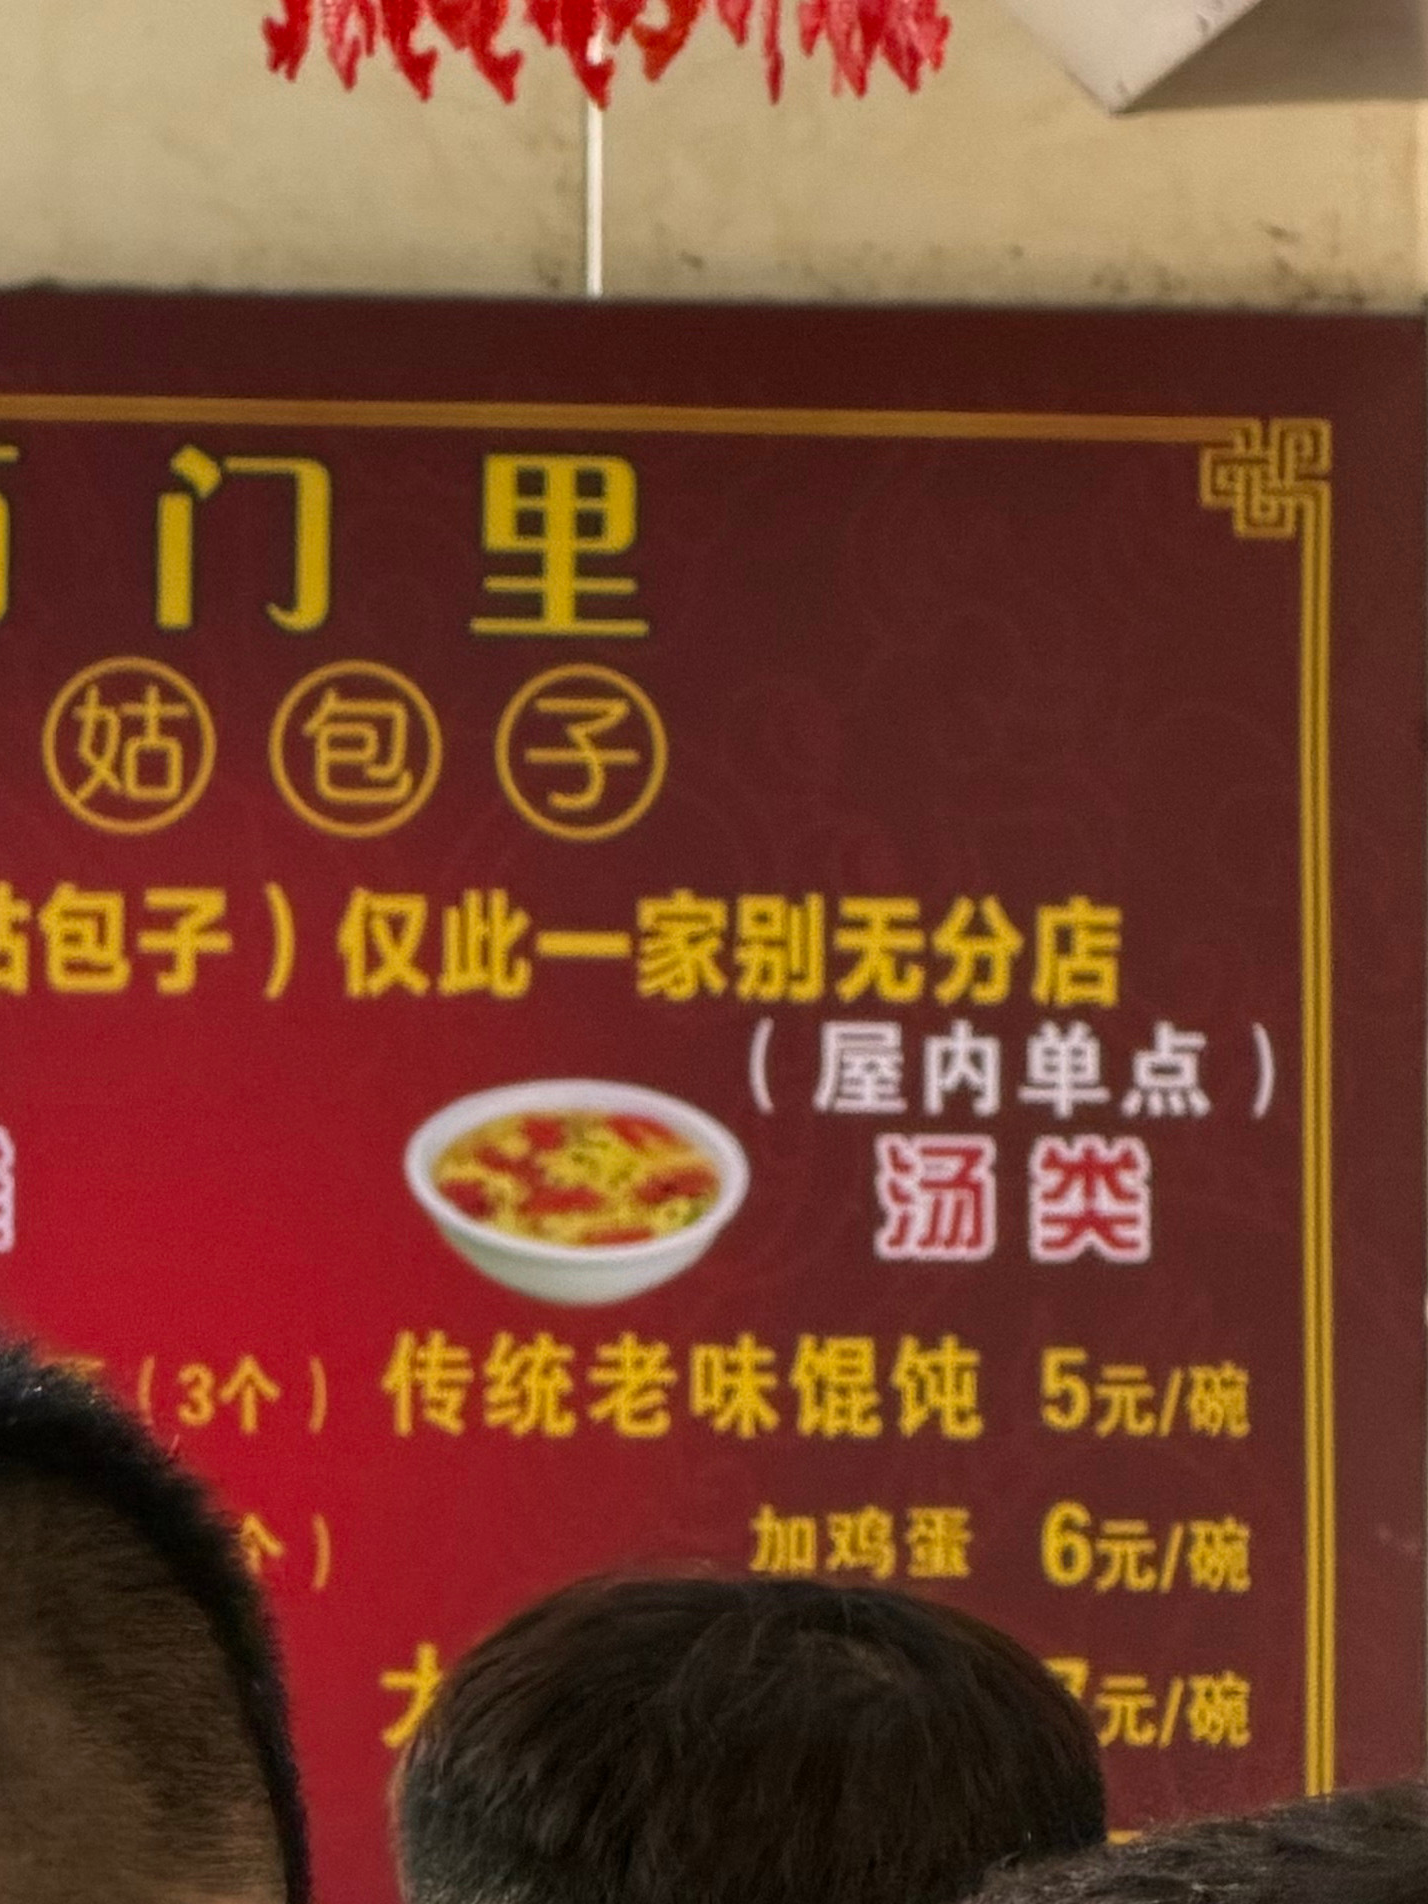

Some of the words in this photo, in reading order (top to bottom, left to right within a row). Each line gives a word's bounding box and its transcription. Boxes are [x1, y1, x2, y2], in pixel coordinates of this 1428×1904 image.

[747, 1022, 1276, 1121] （屋内单点）
[874, 1134, 1152, 1264] 汤类
[381, 1328, 983, 1440] 传统老味馄饨
[1040, 1349, 1251, 1442] 5元/碗
[750, 1508, 974, 1579] 加鸡蛋
[1041, 1500, 1252, 1594] 6元/碗
